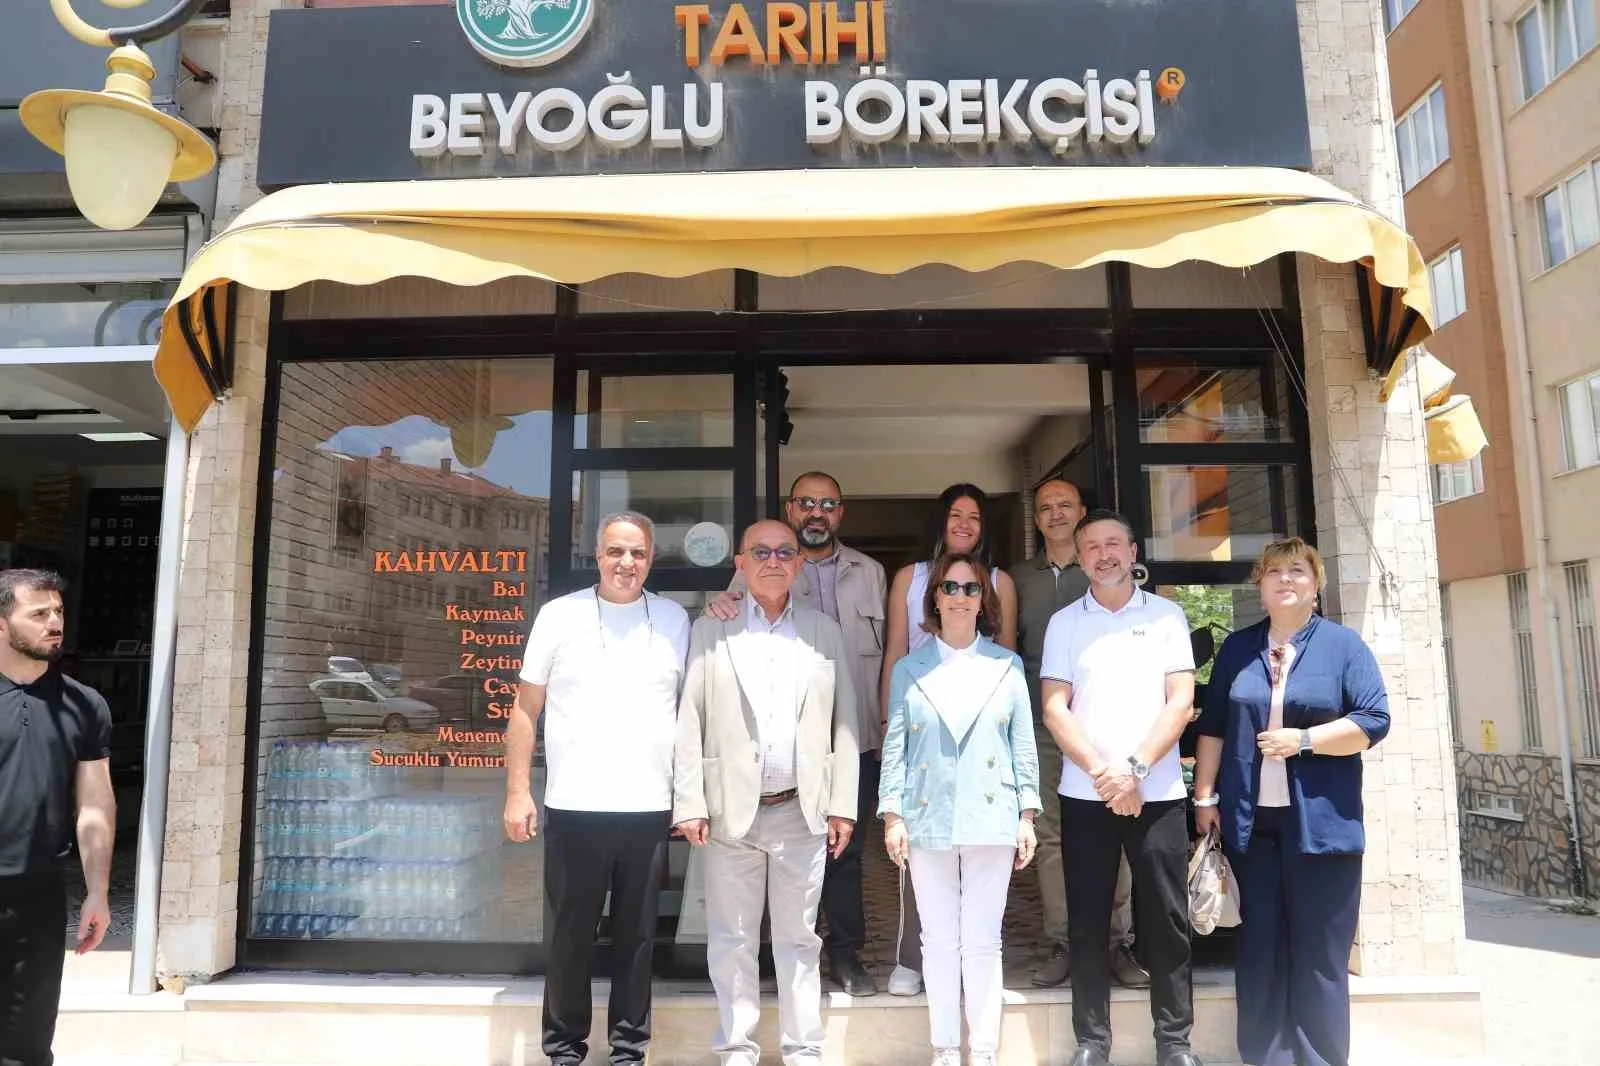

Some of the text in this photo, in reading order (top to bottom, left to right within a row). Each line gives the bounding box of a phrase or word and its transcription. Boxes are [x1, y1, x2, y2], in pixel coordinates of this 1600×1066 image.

[409, 71, 725, 156] BEYOĞLU
[804, 65, 1157, 155] BÖREKÇİSİ
[374, 550, 527, 574] KAHVALTI
[493, 581, 525, 598] Bal
[445, 604, 525, 624] Kaymak
[460, 629, 525, 648] Peynir
[459, 653, 523, 673] Zeytin
[484, 678, 521, 698] Çay
[487, 702, 514, 719] Sü
[437, 726, 508, 744] Menem
[370, 750, 508, 767] Sucuklu Yumur
